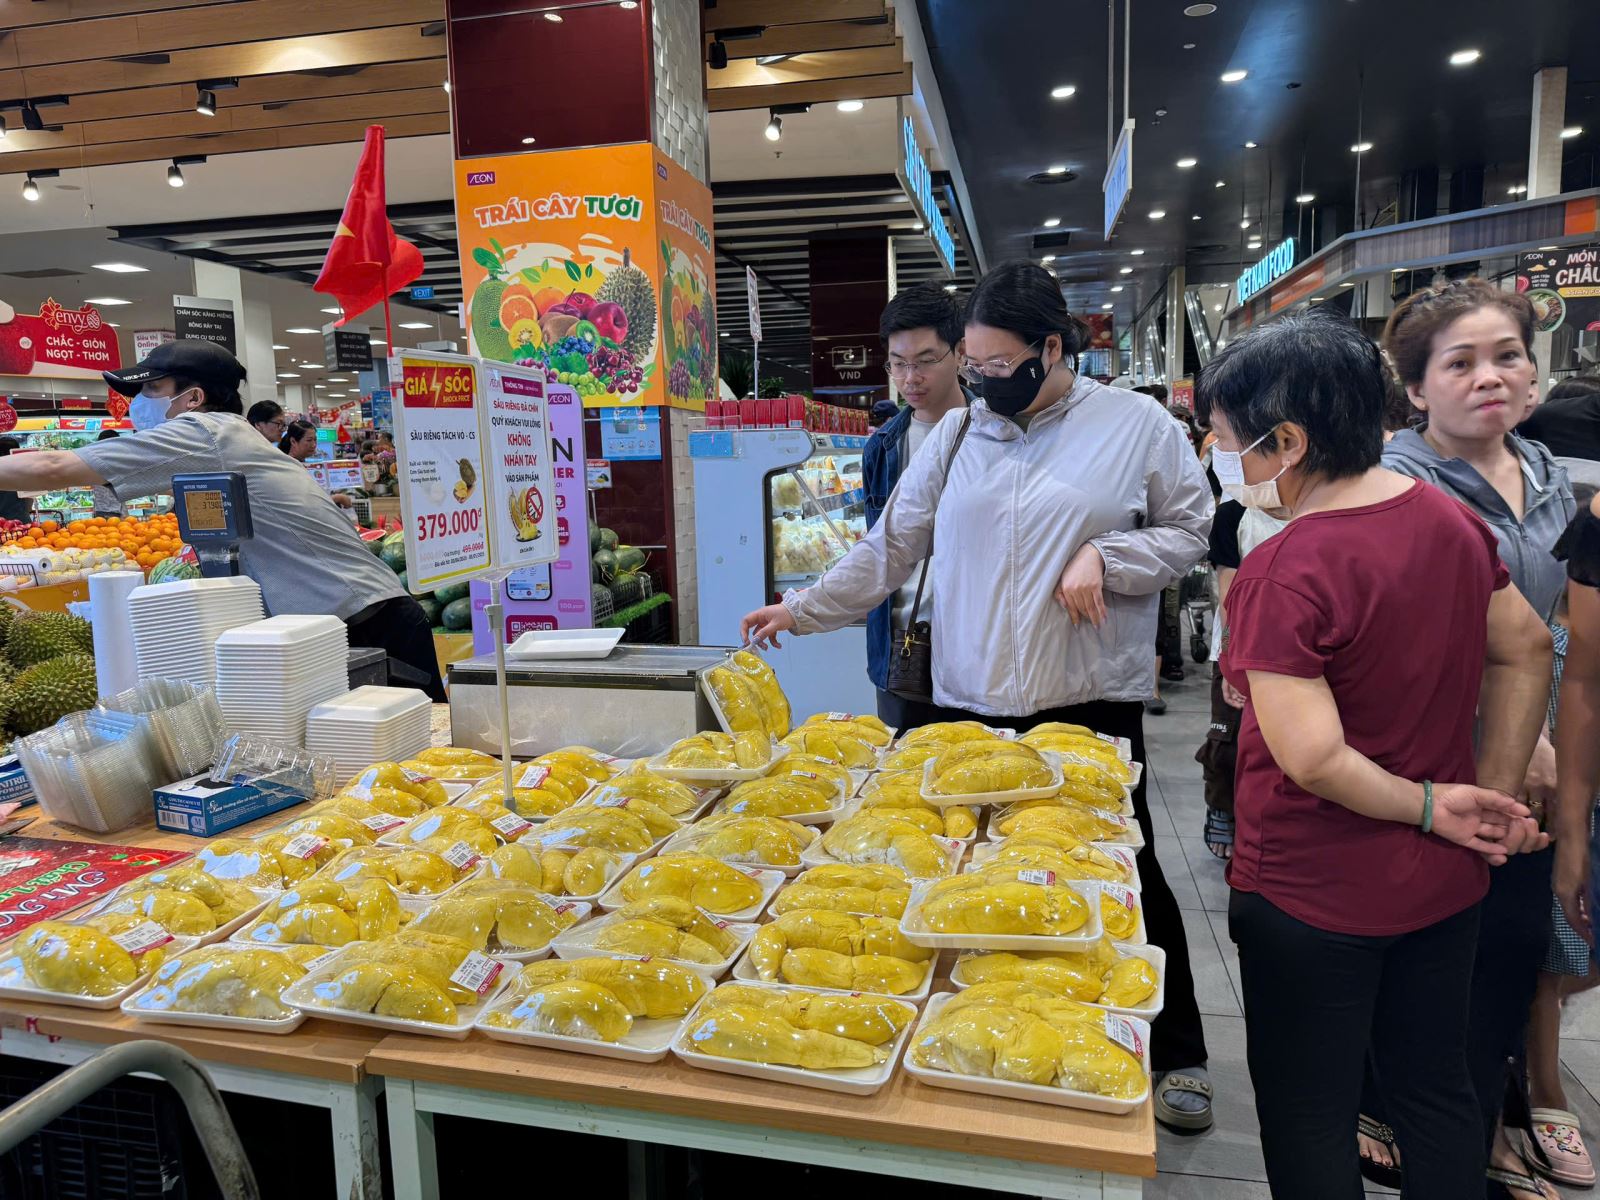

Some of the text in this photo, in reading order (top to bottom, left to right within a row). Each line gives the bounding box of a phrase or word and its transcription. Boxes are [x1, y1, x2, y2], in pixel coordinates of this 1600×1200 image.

[475, 195, 642, 227] TRÁI CÂY TƯƠI
[1269, 237, 1294, 282] FOOD
[1566, 250, 1597, 264] MÓN
[55, 311, 86, 332] envy
[46, 334, 74, 347] CHẮC
[82, 338, 106, 350] GIÒN
[46, 349, 74, 361] NGỌT
[82, 351, 110, 361] THƠM
[404, 369, 470, 396] GIÁ SỐC
[839, 371, 861, 380] VND
[507, 431, 532, 447] KHÔNG
[503, 450, 537, 467] NHẤN TAY
